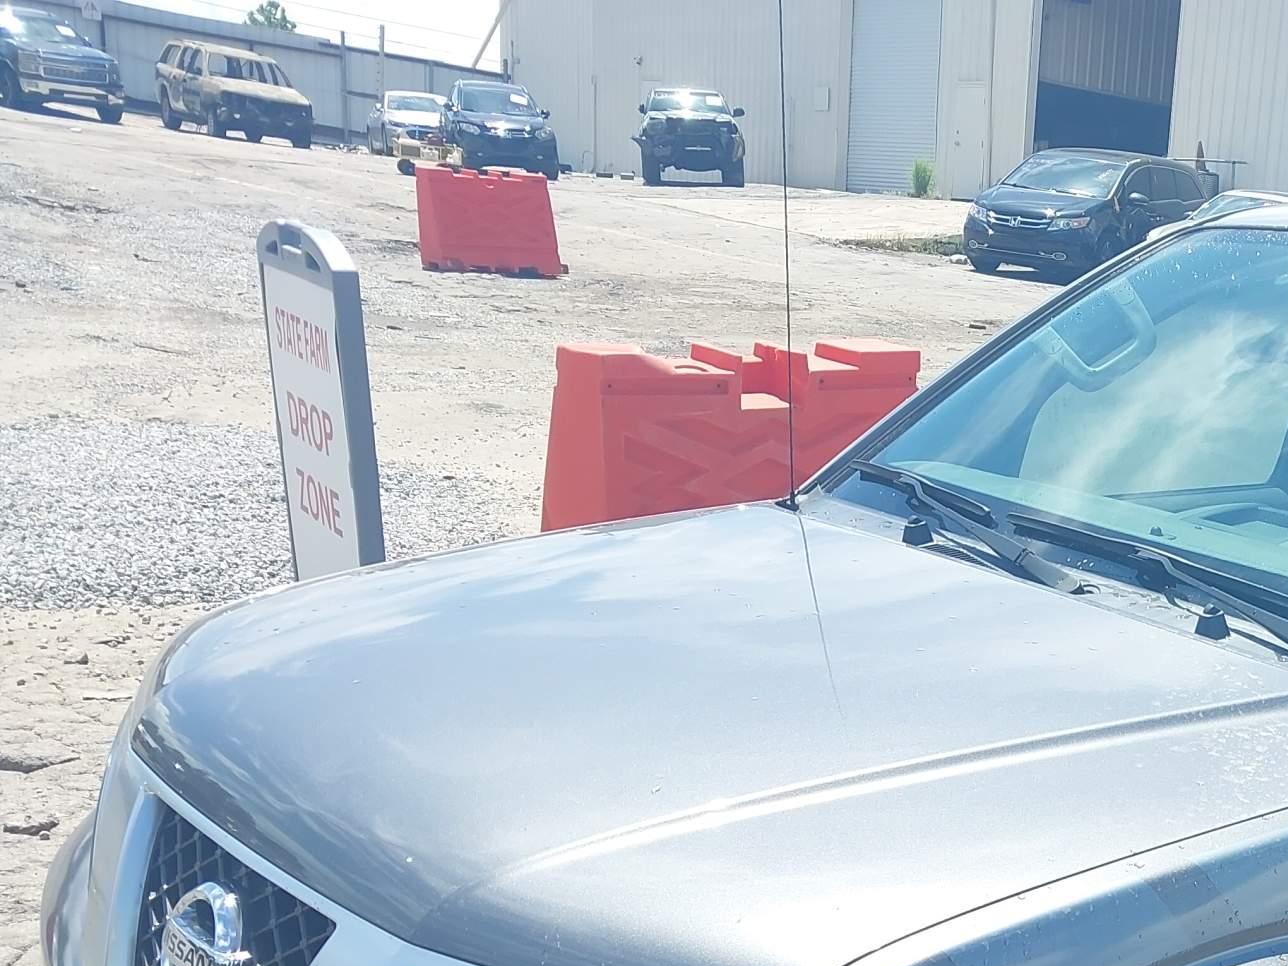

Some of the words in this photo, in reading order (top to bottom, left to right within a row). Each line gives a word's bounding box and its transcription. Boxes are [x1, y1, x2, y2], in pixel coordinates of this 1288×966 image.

[275, 306, 303, 360] STATE
[303, 320, 331, 374] FARM
[286, 390, 334, 456] DROP
[296, 467, 343, 538] ZONE
